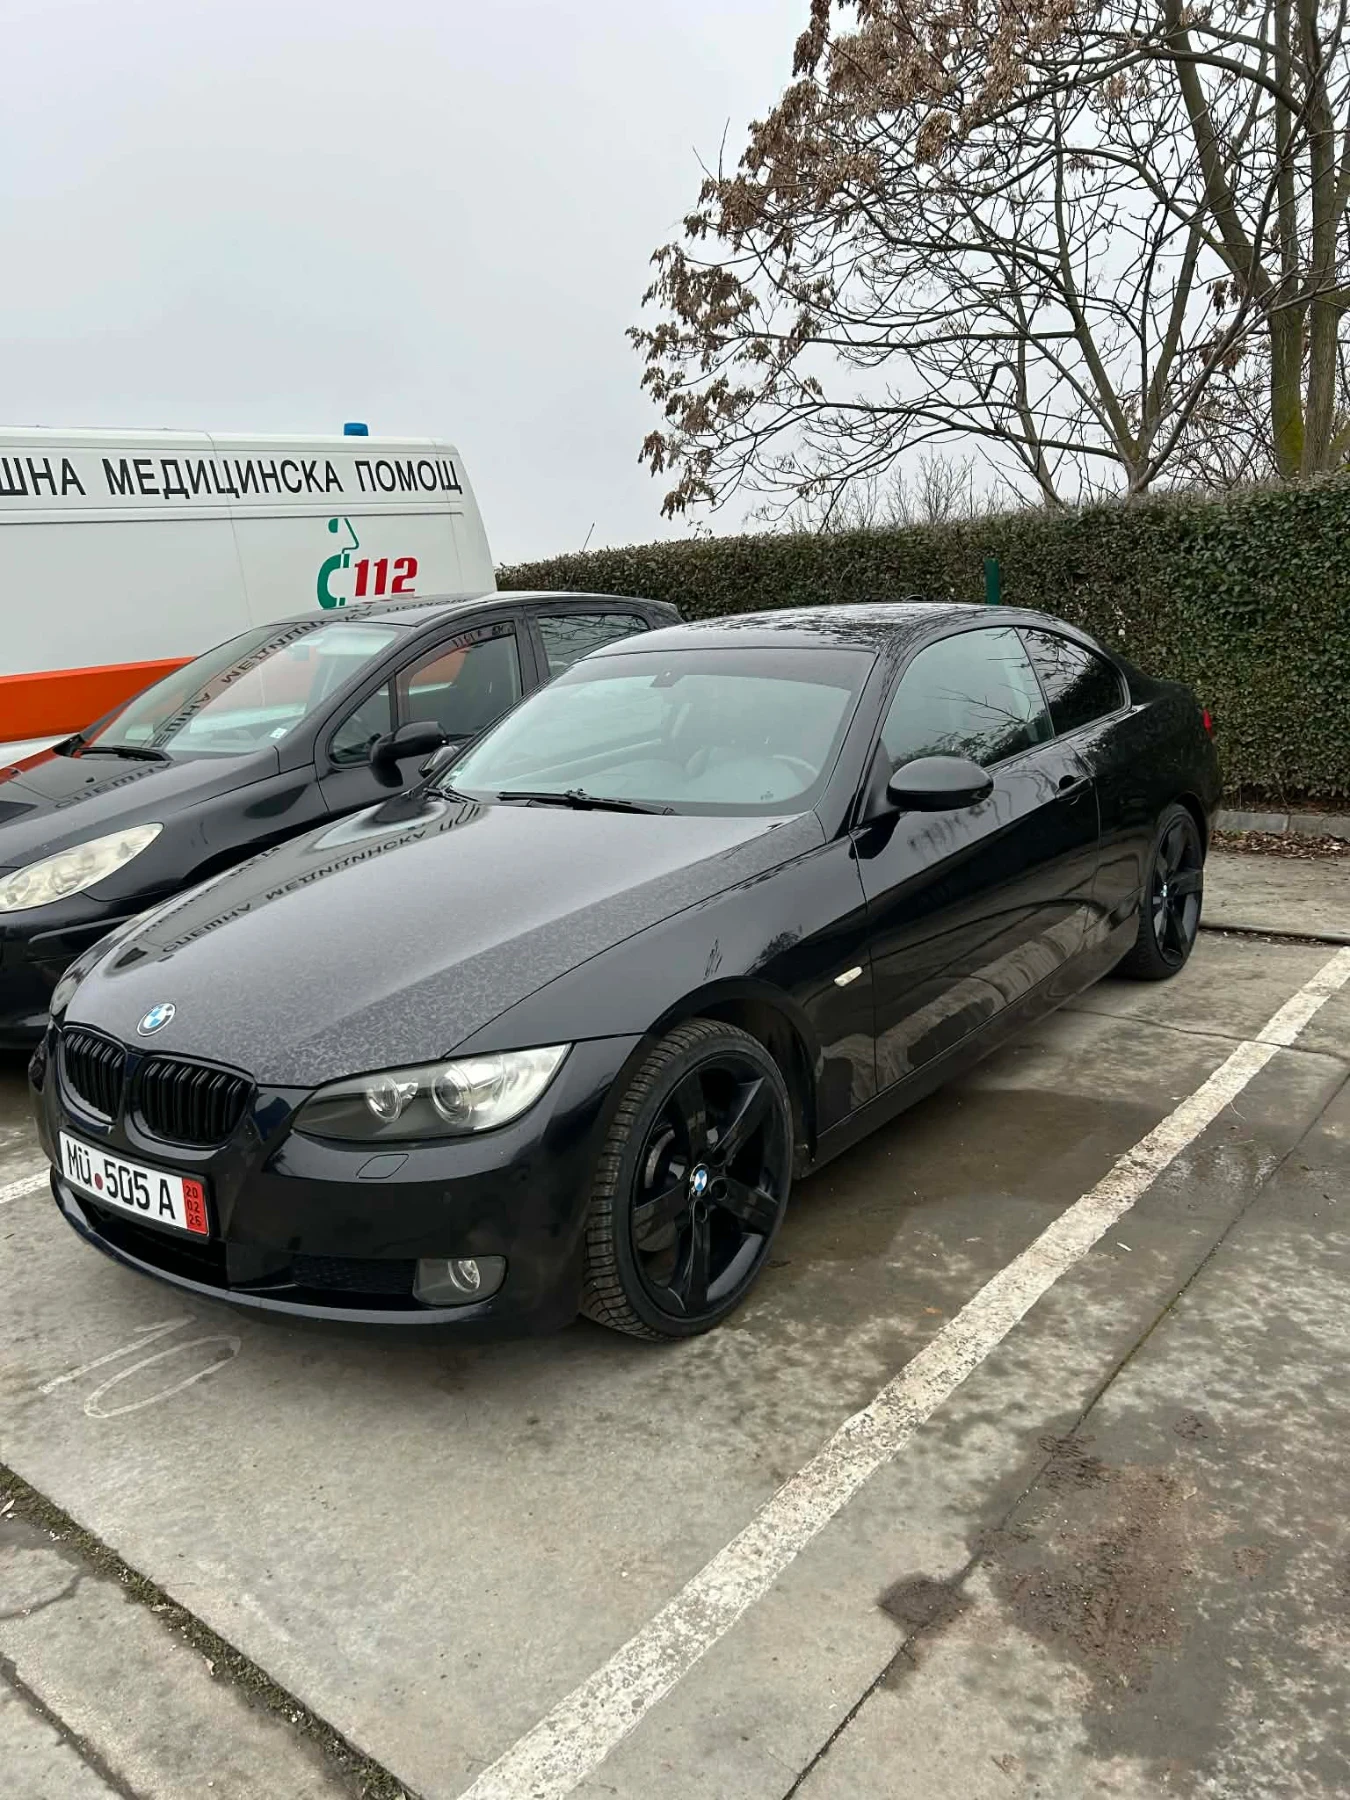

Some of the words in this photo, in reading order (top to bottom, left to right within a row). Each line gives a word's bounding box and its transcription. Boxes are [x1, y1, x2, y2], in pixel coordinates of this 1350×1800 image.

[101, 457, 345, 499] МЕДИЦИНСКА
[354, 459, 463, 496] ПОМОЩ
[353, 556, 419, 597] 112
[66, 1139, 93, 1187] MÜ
[103, 1158, 151, 1211] 505
[159, 1178, 177, 1220] A
[184, 1185, 199, 1199] 20
[186, 1200, 201, 1213] 02
